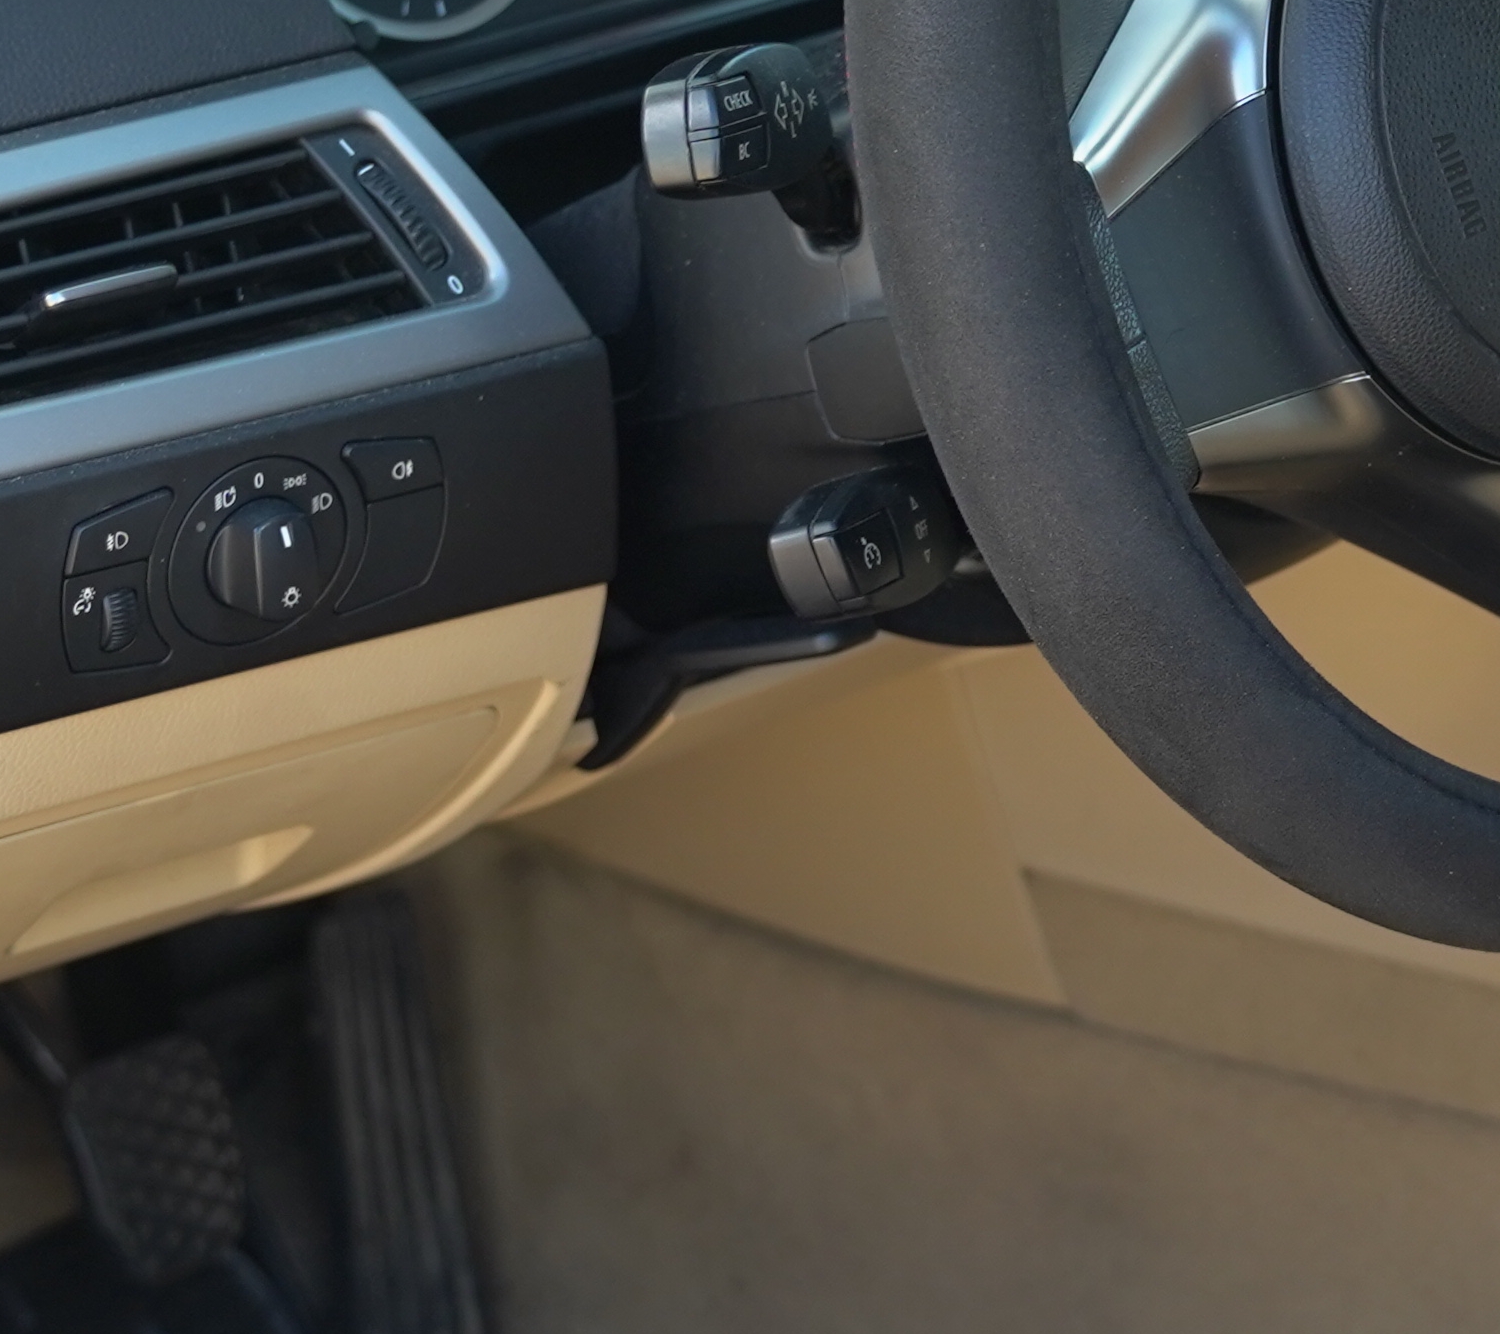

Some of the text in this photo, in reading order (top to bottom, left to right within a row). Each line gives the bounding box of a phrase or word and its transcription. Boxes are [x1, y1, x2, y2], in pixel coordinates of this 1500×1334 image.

[723, 89, 754, 112] CHECK
[738, 141, 751, 161] BC
[1431, 132, 1487, 239] AIRBAG
[254, 472, 265, 490] 0
